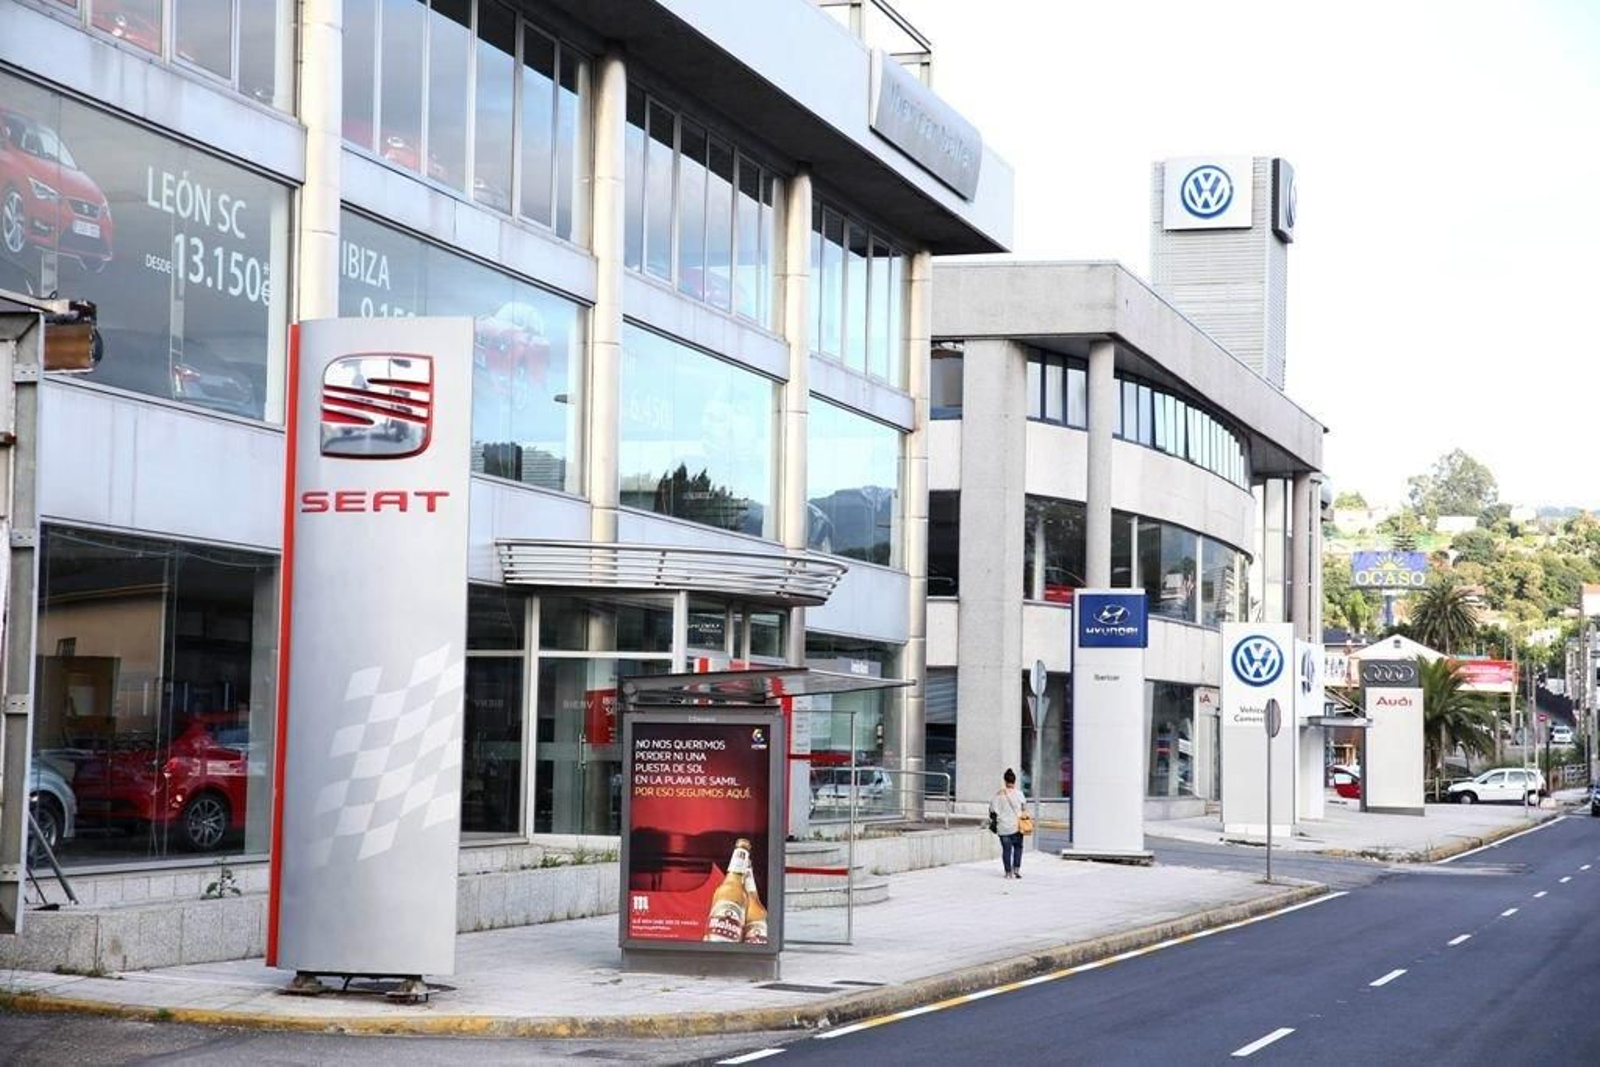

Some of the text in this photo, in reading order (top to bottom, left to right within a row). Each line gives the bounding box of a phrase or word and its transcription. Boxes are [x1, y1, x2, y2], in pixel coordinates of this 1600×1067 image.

[147, 166, 247, 239] LEÓN SC
[342, 240, 391, 291] IBIZA
[301, 491, 450, 513] SEAT
[1355, 570, 1426, 586] OCASO
[1376, 696, 1413, 707] Audi
[636, 739, 726, 750] NO NOS QUEREMOS
[635, 750, 707, 761] PERDER NI UNA
[635, 763, 705, 774] PUESTA DE SOL
[635, 774, 649, 785] EN
[649, 775, 662, 785] LA
[664, 775, 693, 786] PLAYA
[694, 775, 707, 786] DE
[635, 786, 654, 797] POR
[656, 787, 674, 798] ESO
[675, 788, 724, 799] SEGUIMOS
